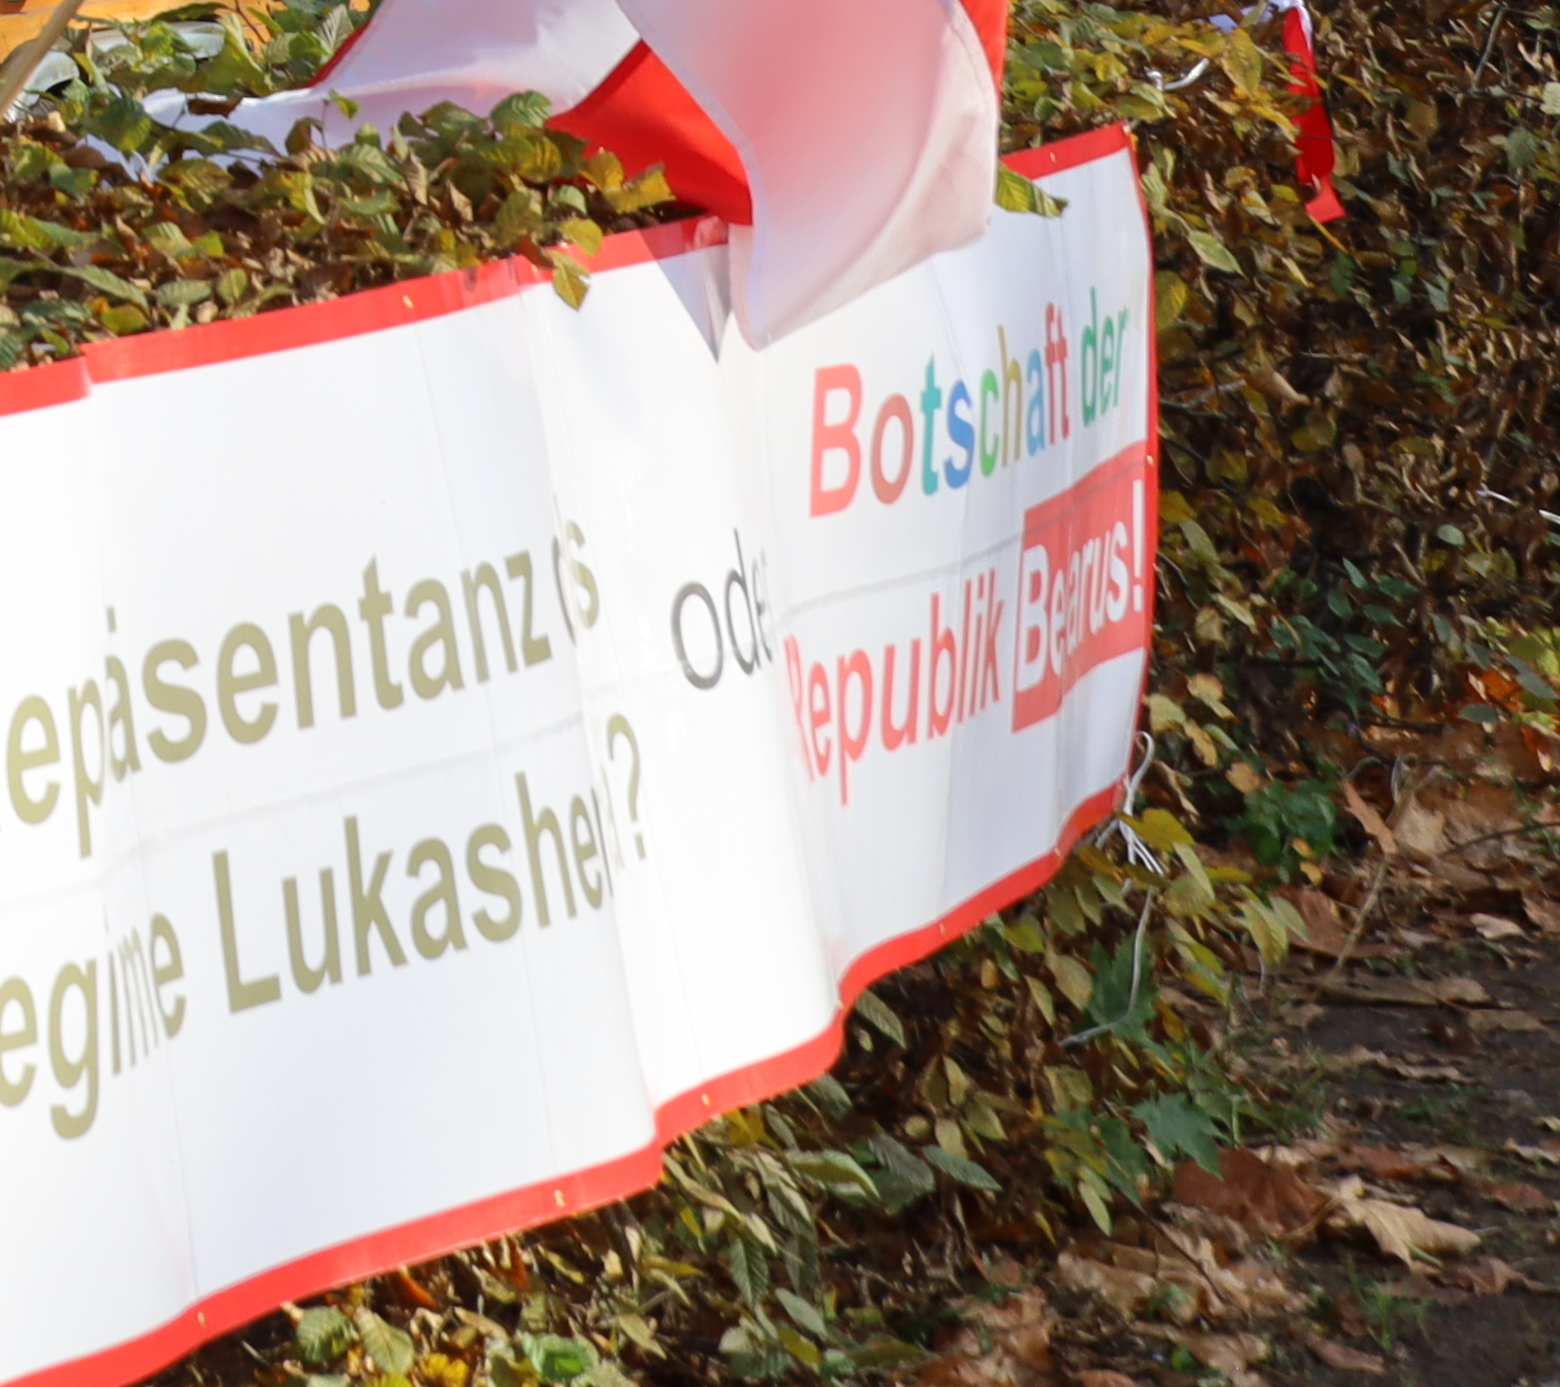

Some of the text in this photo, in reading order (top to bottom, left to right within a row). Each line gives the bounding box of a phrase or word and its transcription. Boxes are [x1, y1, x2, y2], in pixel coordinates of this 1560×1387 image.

[810, 286, 1130, 519] Botschaft der
[1014, 479, 1146, 693] Bearus!
